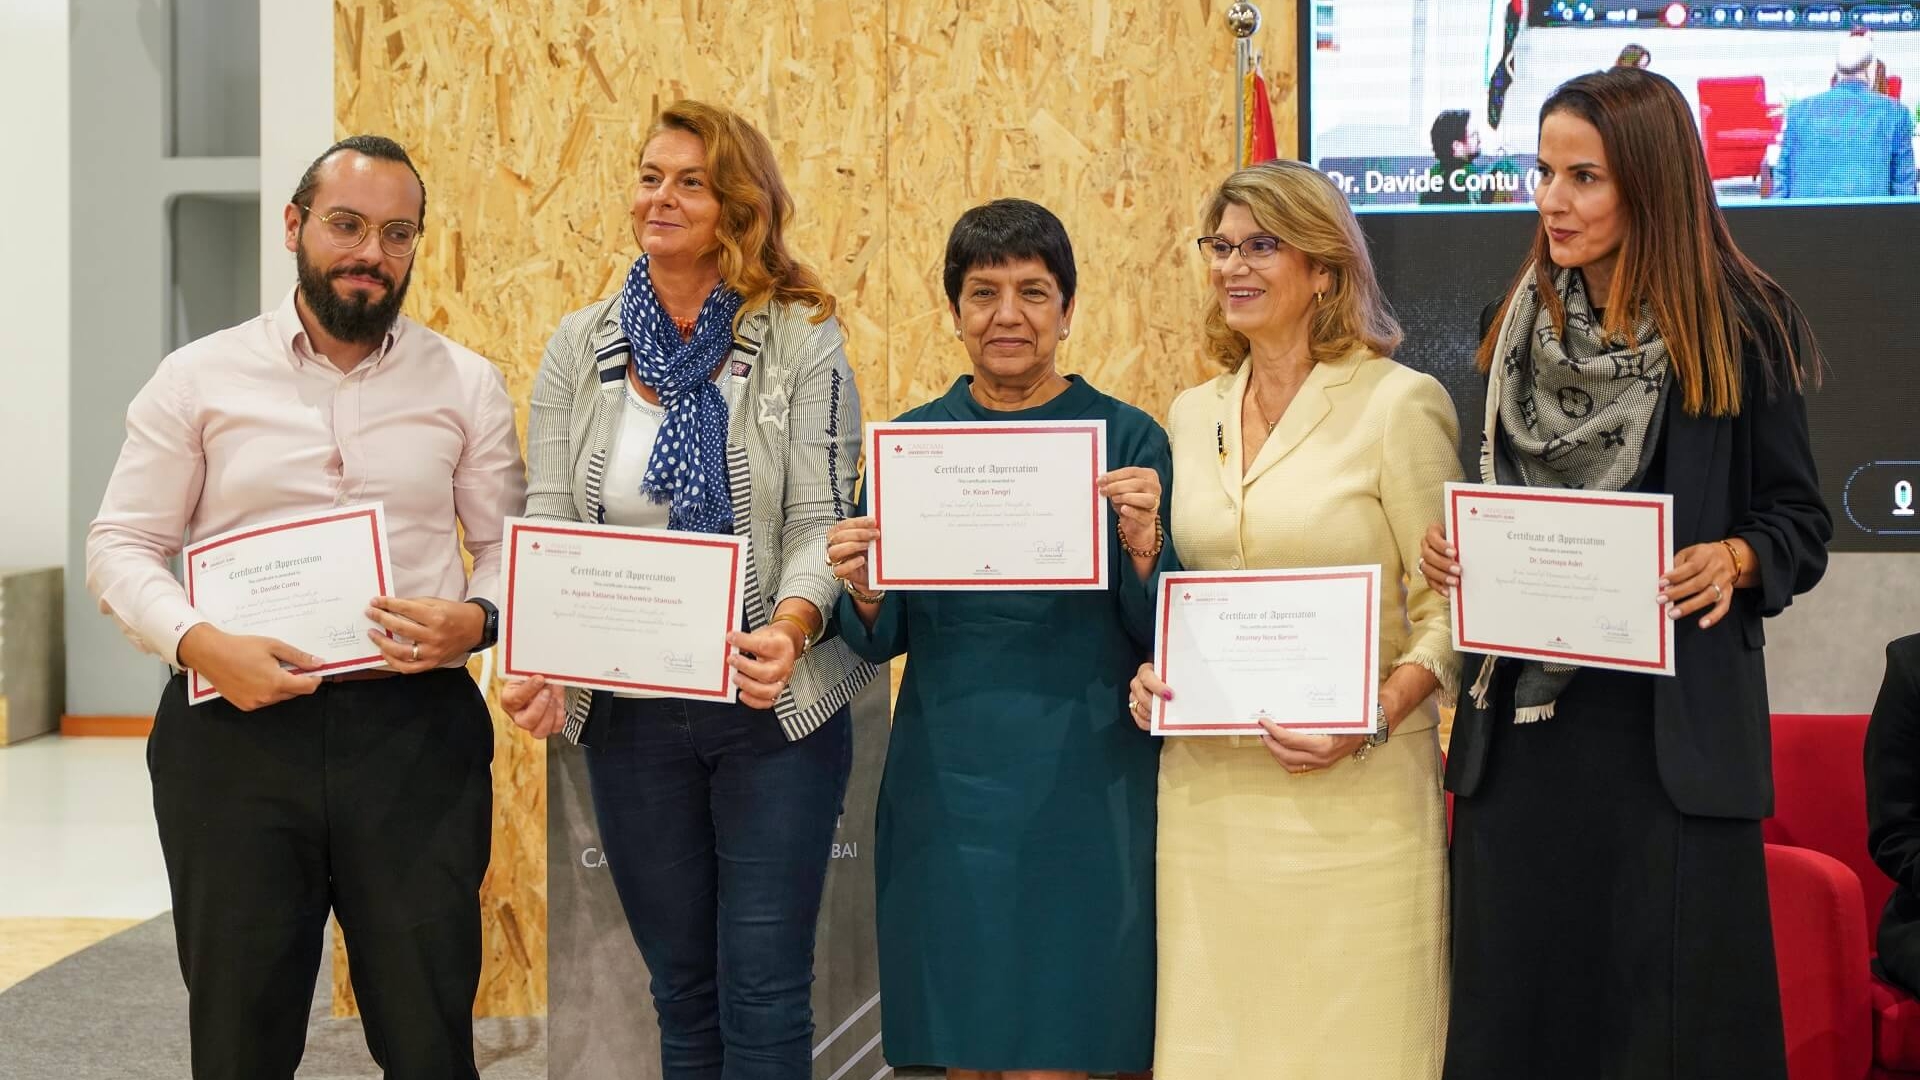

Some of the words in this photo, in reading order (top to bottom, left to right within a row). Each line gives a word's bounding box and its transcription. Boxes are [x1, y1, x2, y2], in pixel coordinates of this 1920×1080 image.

[1364, 169, 1444, 193] Davide
[1449, 169, 1519, 193] Contu
[934, 465, 976, 475] Certificate
[978, 465, 987, 474] of
[989, 464, 1039, 475] Appreciation
[1506, 531, 1545, 542] Certificate
[1547, 533, 1555, 542] of
[1558, 534, 1606, 546] Appreciation
[1529, 556, 1538, 564] Dr.
[228, 564, 262, 580] Certificate
[264, 562, 272, 571] of
[274, 555, 323, 570] Appreciation
[570, 566, 612, 578] Certificate
[614, 570, 624, 578] of
[625, 570, 676, 583] Appreciation
[251, 587, 260, 595] Dr.
[260, 583, 281, 593] Davide
[281, 581, 300, 590] Contu
[561, 588, 571, 596] Dr.
[1218, 611, 1258, 621] Certificate
[1259, 611, 1267, 620] of
[1270, 610, 1317, 621] Appreciation
[831, 842, 858, 860] BAI
